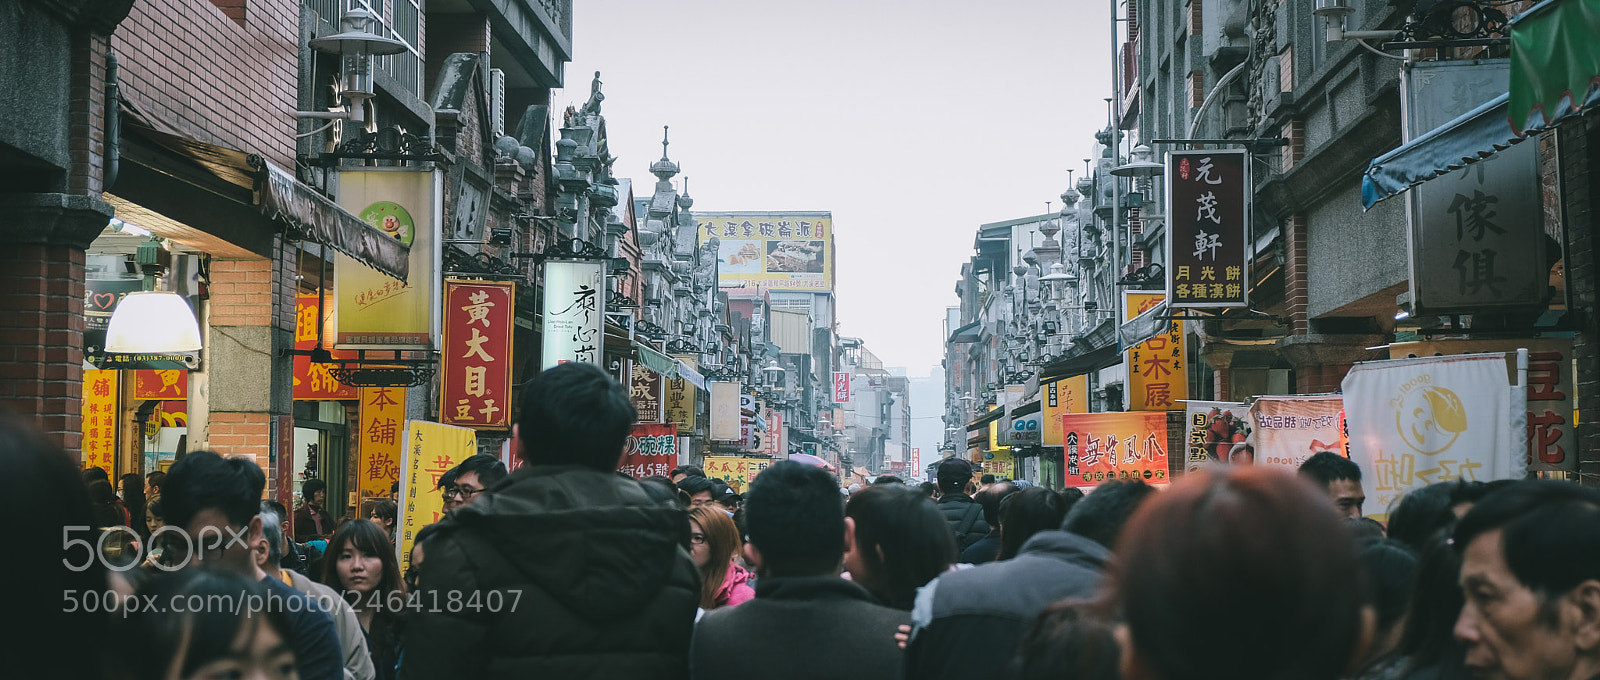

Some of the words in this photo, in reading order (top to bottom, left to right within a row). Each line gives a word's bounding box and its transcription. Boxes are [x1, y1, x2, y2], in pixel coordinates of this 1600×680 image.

[1193, 157, 1222, 262] 元茂軒
[1176, 265, 1241, 281] 月光餅
[1176, 283, 1241, 299] 各種漢餅
[461, 290, 496, 398] 黃大目
[837, 373, 847, 401] 月光餅
[454, 399, 500, 423] 豆干
[1015, 419, 1037, 431] QQ
[1080, 432, 1166, 467] 無骨鳳爪
[708, 461, 747, 473] 冬瓜茶
